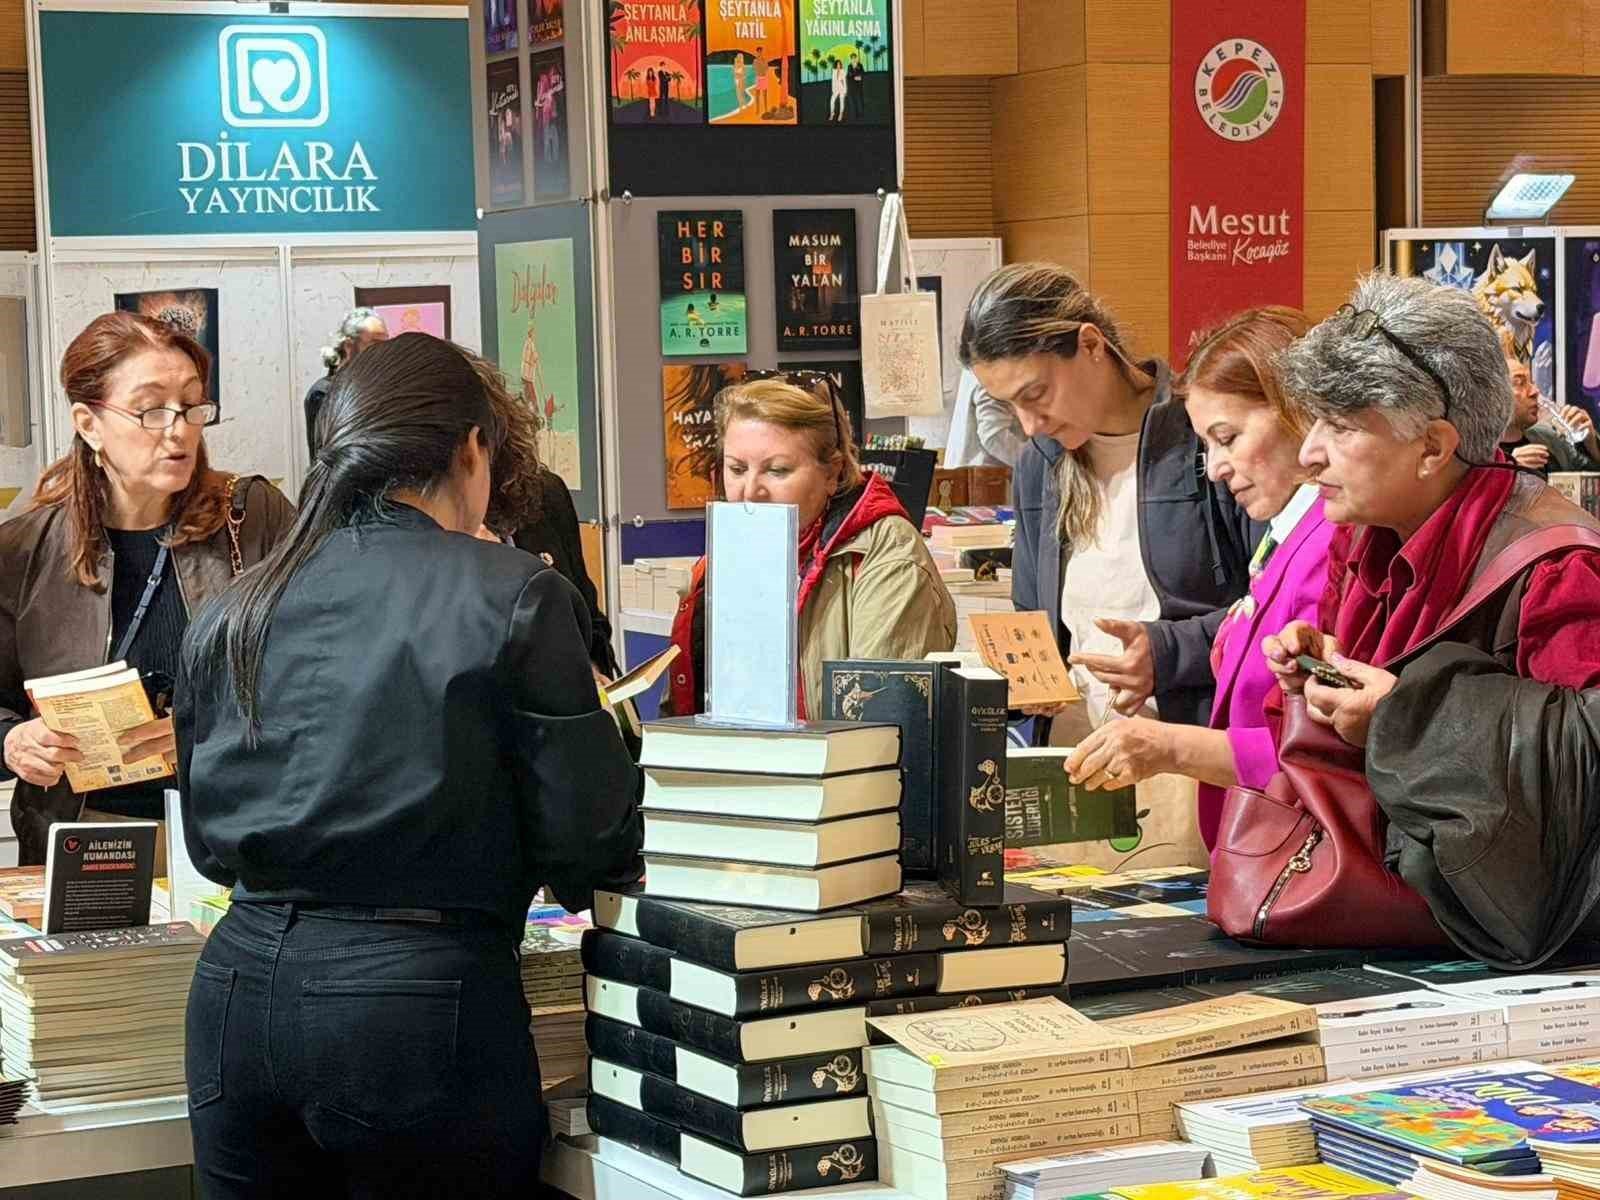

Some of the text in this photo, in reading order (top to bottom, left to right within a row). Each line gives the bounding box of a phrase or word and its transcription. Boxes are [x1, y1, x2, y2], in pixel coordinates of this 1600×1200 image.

[719, 0, 782, 22] ŞEYTANLA
[625, 25, 686, 47] ANLAŞMA
[733, 18, 767, 39] TATİL
[805, 19, 881, 39] YAKINLAŞMA
[1201, 42, 1277, 78] KEPEZ
[176, 130, 379, 182] DİLARA
[178, 185, 381, 215] YAYINCILIK
[677, 220, 726, 239] HER
[1188, 205, 1290, 236] Mesut
[788, 233, 842, 248] MASUM
[681, 242, 722, 264] BİR
[804, 251, 827, 267] BİR
[1232, 237, 1290, 267] Kocagöz
[682, 271, 723, 290] SIR
[791, 273, 843, 288] YALAN
[670, 325, 741, 339] A. R. TORRE
[783, 324, 853, 338] A. R. TORRE
[672, 409, 718, 425] HAYA
